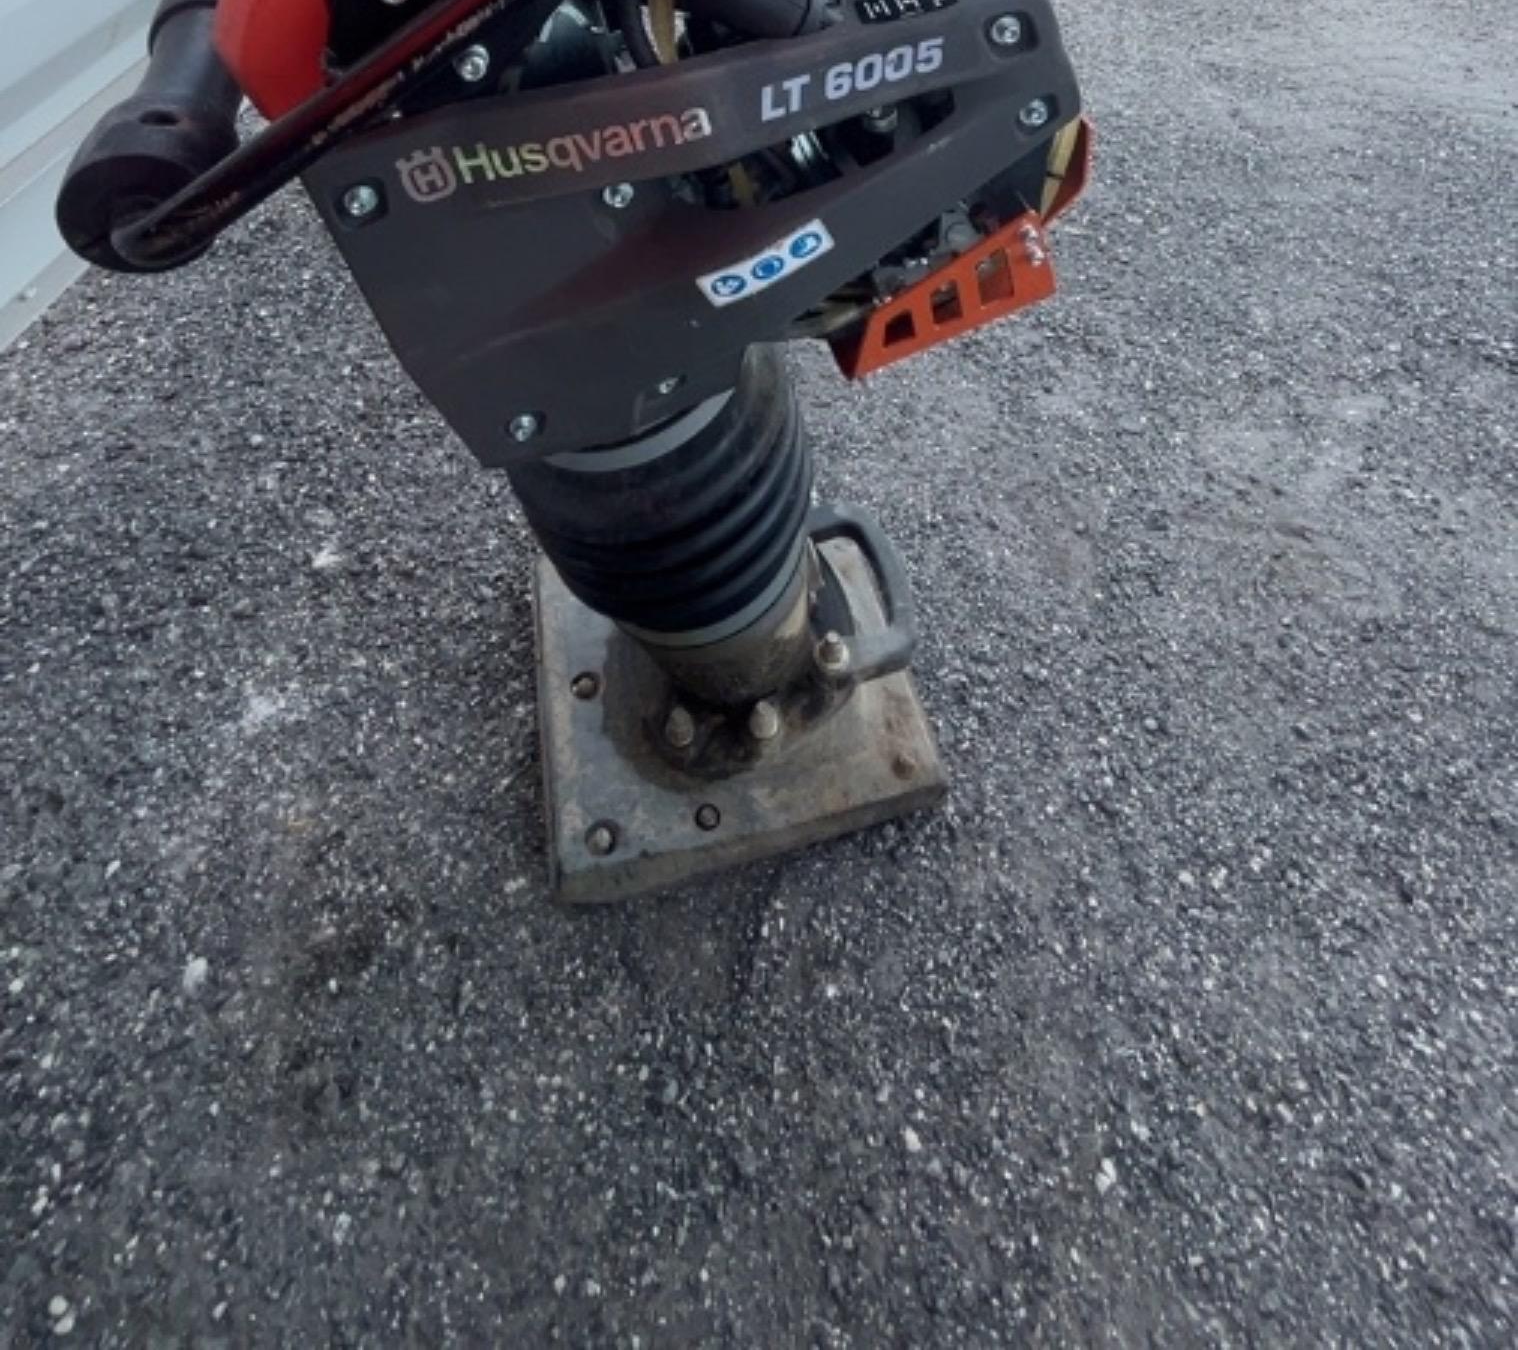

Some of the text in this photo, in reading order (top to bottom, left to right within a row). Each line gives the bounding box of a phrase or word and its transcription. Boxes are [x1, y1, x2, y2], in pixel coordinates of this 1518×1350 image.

[761, 37, 944, 122] LT 6005
[452, 106, 711, 184] Husqvarna
